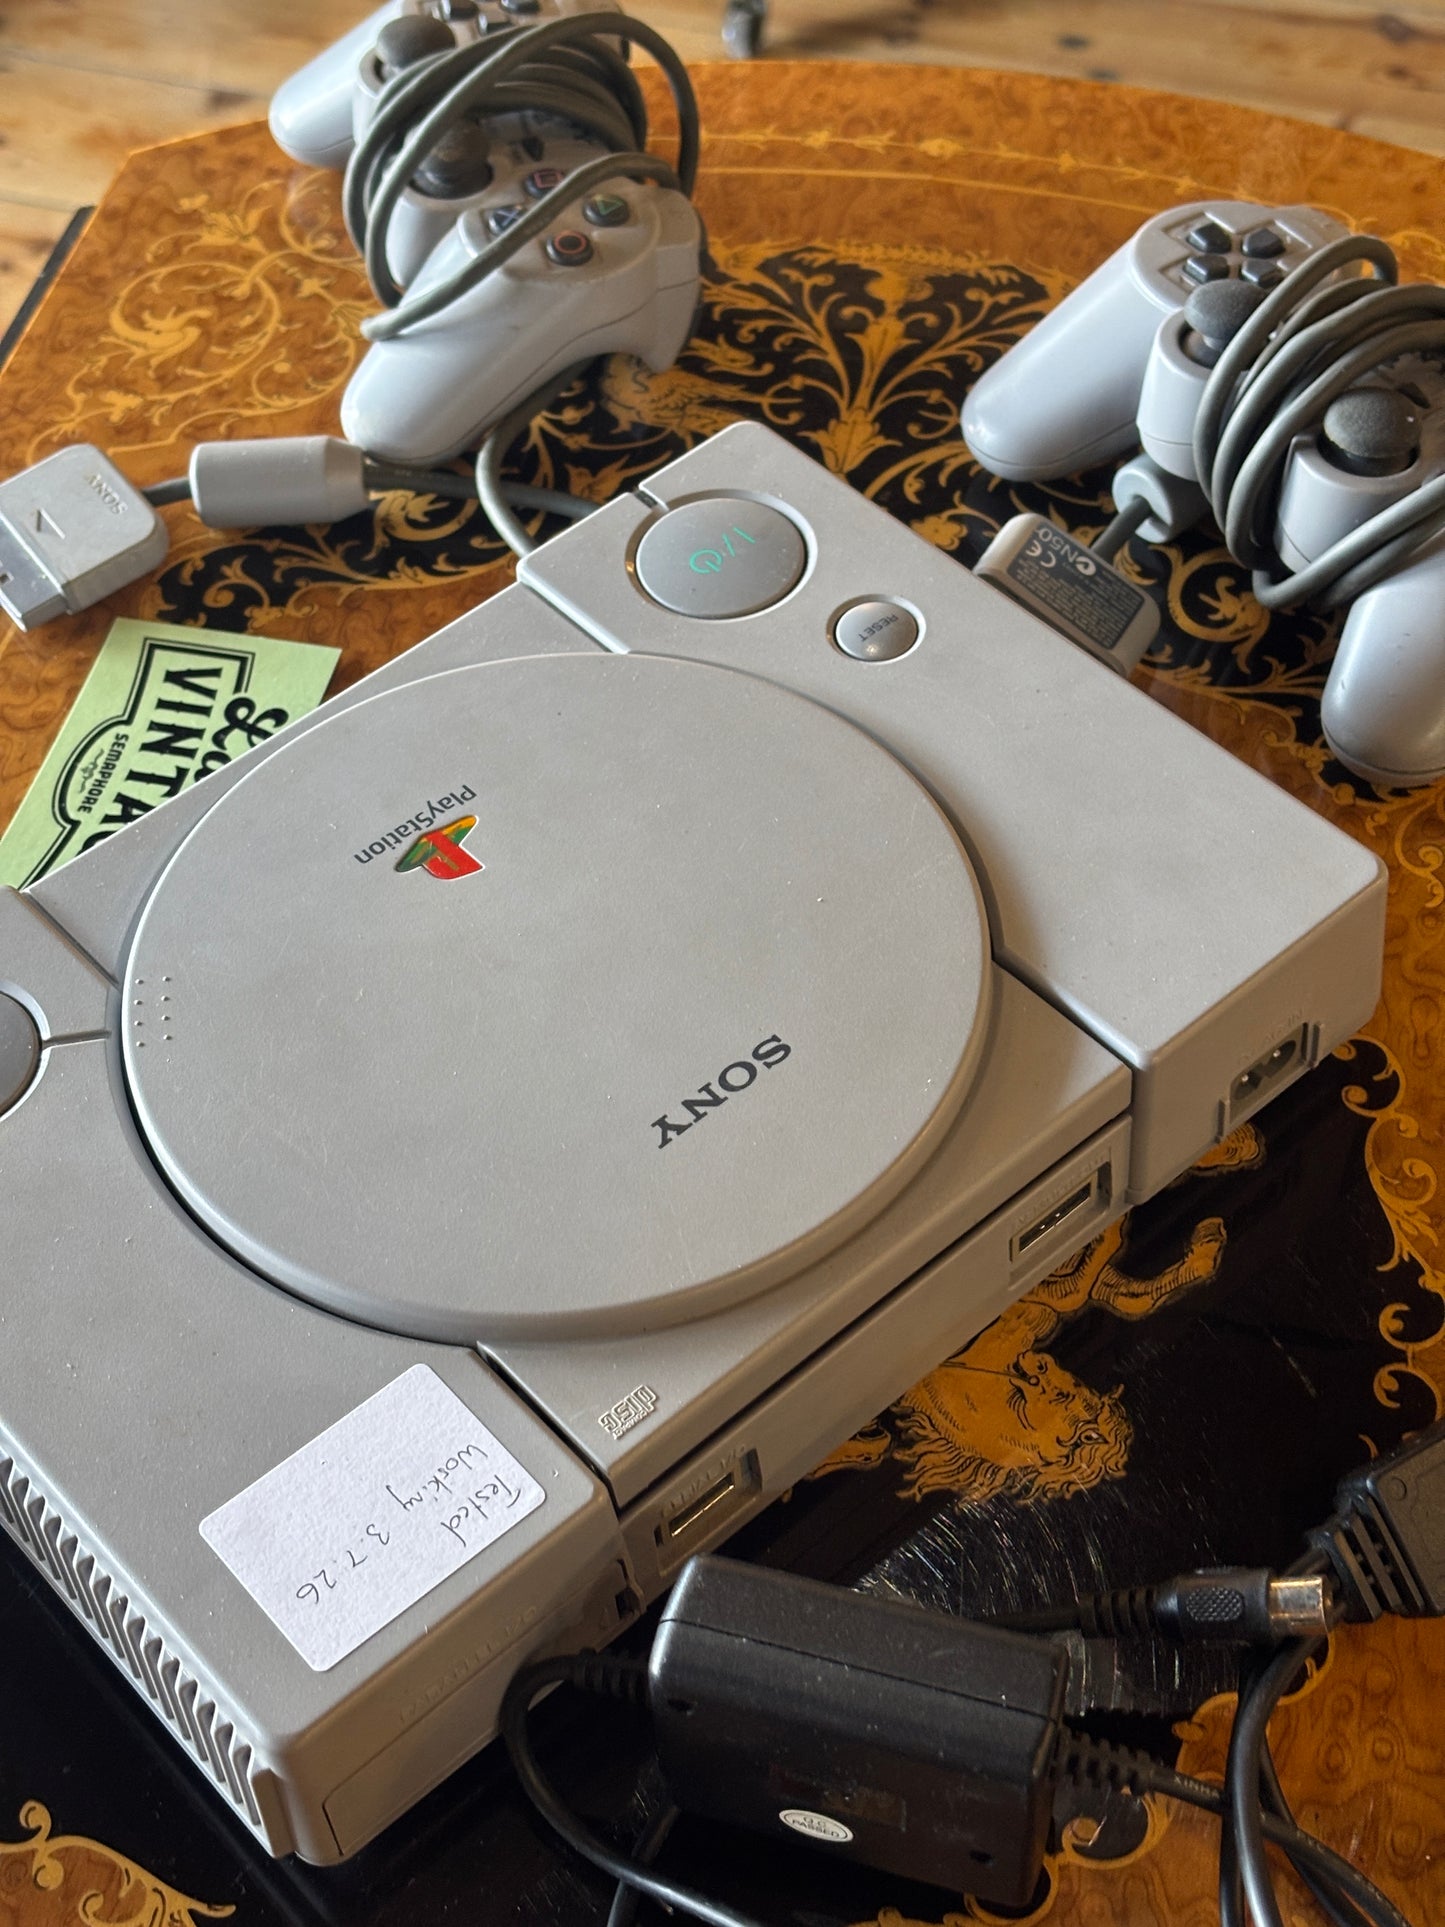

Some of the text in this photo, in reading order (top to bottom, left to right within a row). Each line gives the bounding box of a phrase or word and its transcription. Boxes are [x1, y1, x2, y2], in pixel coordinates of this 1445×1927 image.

[87, 473, 129, 515] SONY
[858, 614, 899, 642] RESET
[76, 732, 130, 815] SEMAPHORE
[353, 784, 478, 865] PlayStation
[650, 1033, 792, 1150] SONY
[386, 1444, 488, 1512] Working
[440, 1474, 521, 1548] Tested
